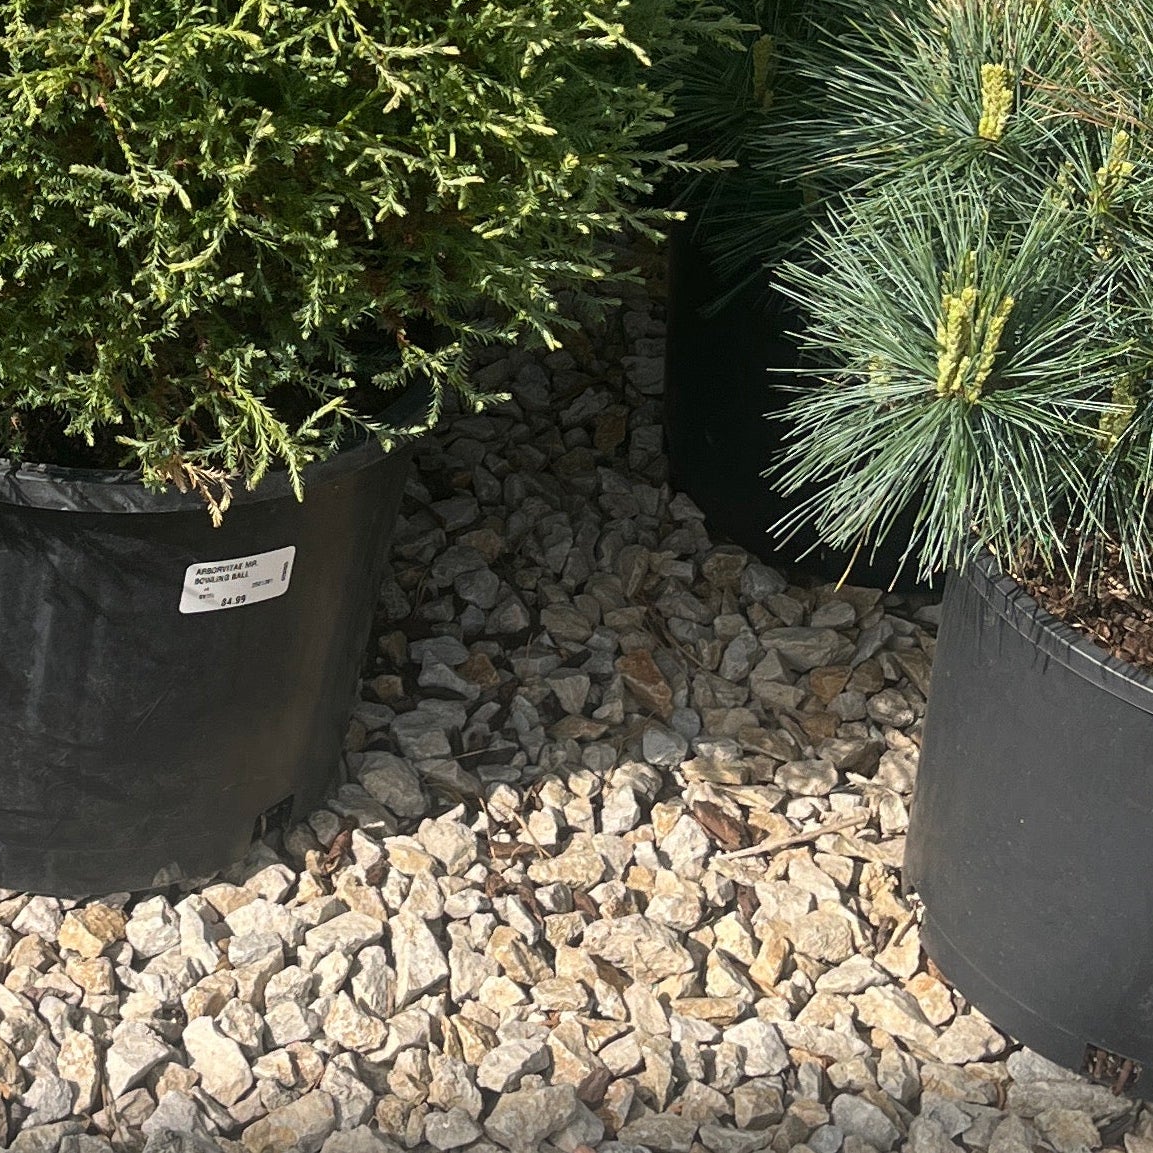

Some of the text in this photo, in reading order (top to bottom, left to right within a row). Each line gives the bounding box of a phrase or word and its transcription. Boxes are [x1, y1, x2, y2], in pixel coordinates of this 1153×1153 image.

[196, 563, 243, 576] ARBORVITAE
[194, 571, 249, 585] BOWLING BALL
